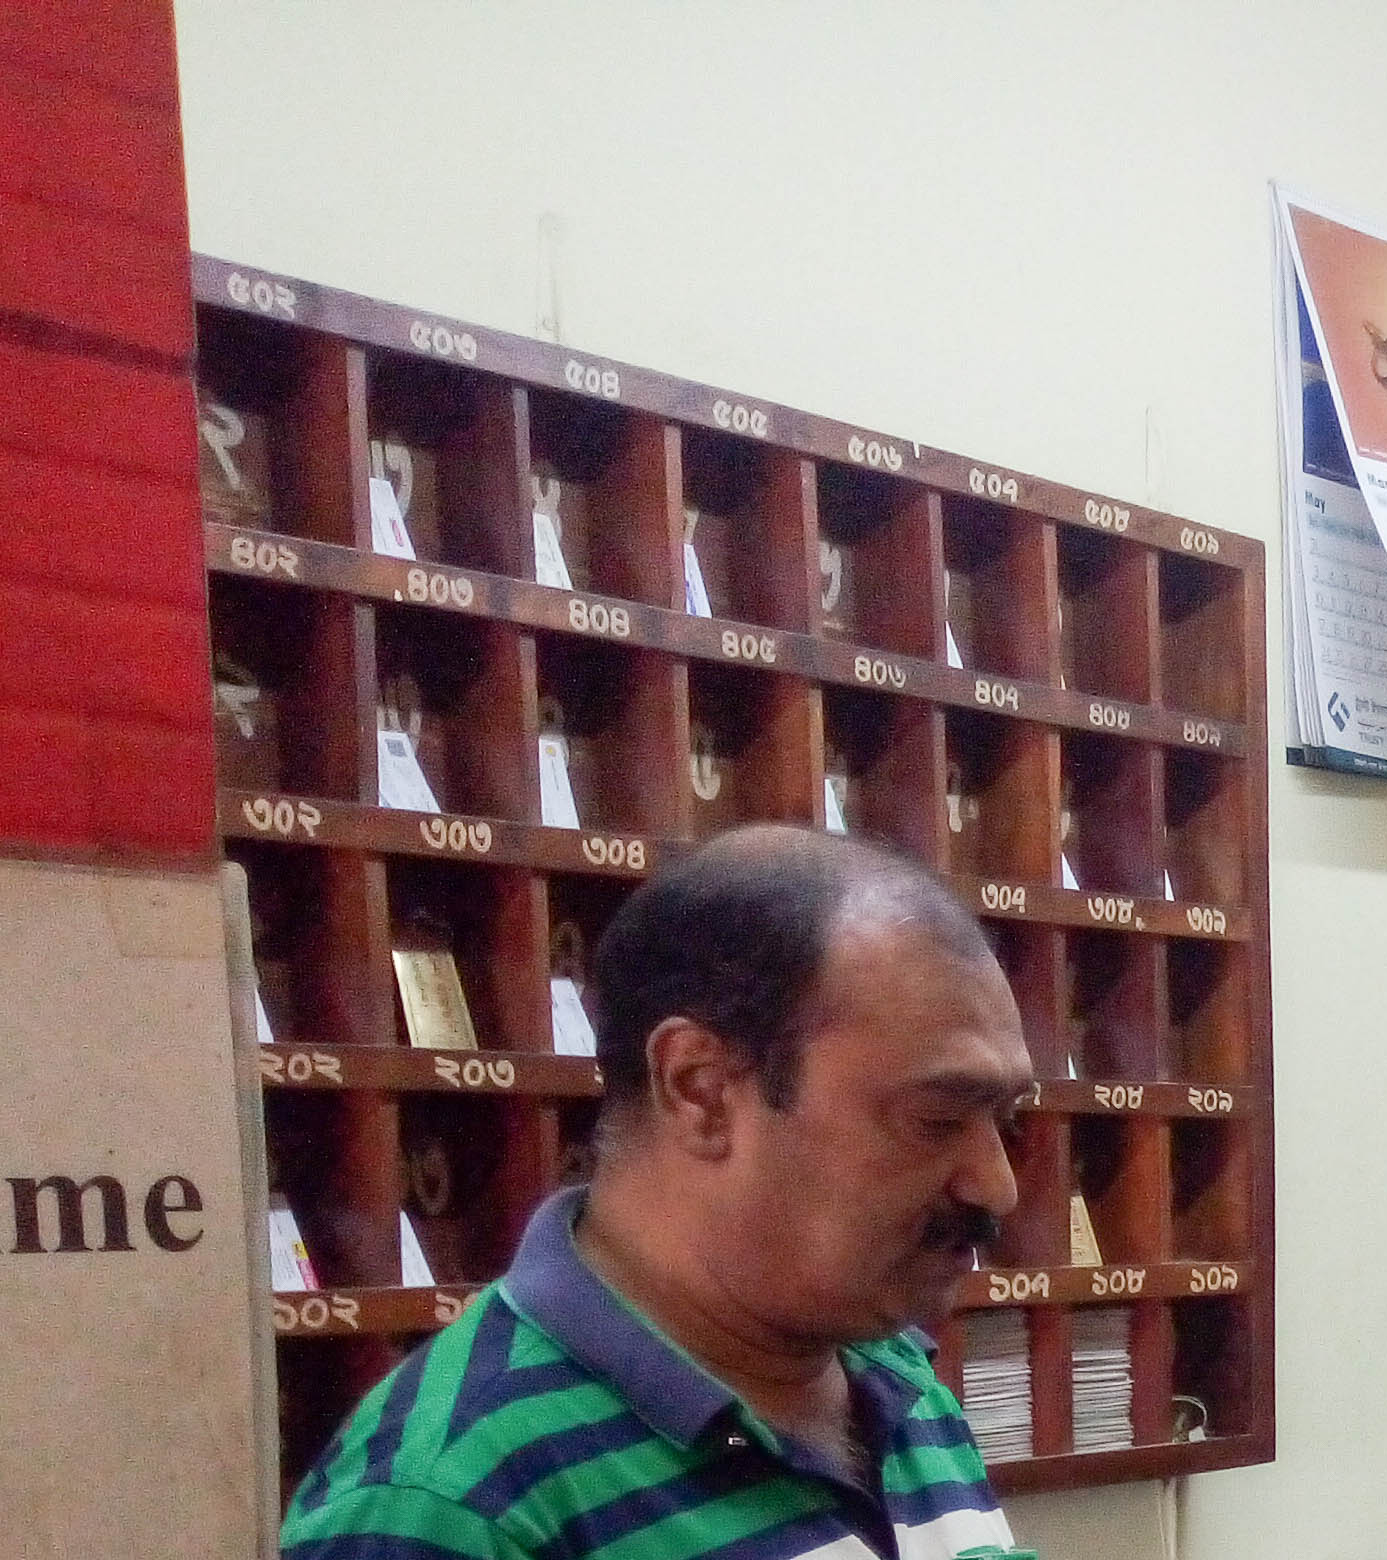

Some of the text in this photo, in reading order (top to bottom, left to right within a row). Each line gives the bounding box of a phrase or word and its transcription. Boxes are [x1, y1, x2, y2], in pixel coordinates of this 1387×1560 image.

[226, 272, 296, 322] ৫০২
[564, 358, 621, 399] ৫০৪
[712, 400, 768, 438] ৫০৫
[847, 434, 903, 472] ৫০৬
[968, 468, 1019, 503] ৫০৭
[1304, 489, 1327, 515] May
[229, 536, 299, 580] ৪০২
[407, 568, 474, 608] ৪০৩
[568, 599, 631, 638] ৪০৪
[721, 629, 777, 664] ৪০৫
[853, 655, 907, 689] ৪০৬
[974, 679, 1020, 712] ৪০৭
[242, 798, 321, 838] ৩০২
[419, 818, 493, 853] ৩০৩
[582, 837, 646, 870] ৩০৪
[981, 883, 1026, 914] ৩০৭
[1087, 896, 1135, 924] ৩০৮
[1186, 906, 1227, 936] ৩০৯
[434, 1056, 515, 1088] ২০৩
[1094, 1084, 1144, 1110] ২০৮
[1187, 1086, 1234, 1113] ২০৯
[5, 1174, 205, 1255] me
[988, 1271, 1050, 1302] ১০৭
[1091, 1267, 1147, 1296] ১০৮
[1190, 1263, 1239, 1294] ১০৯
